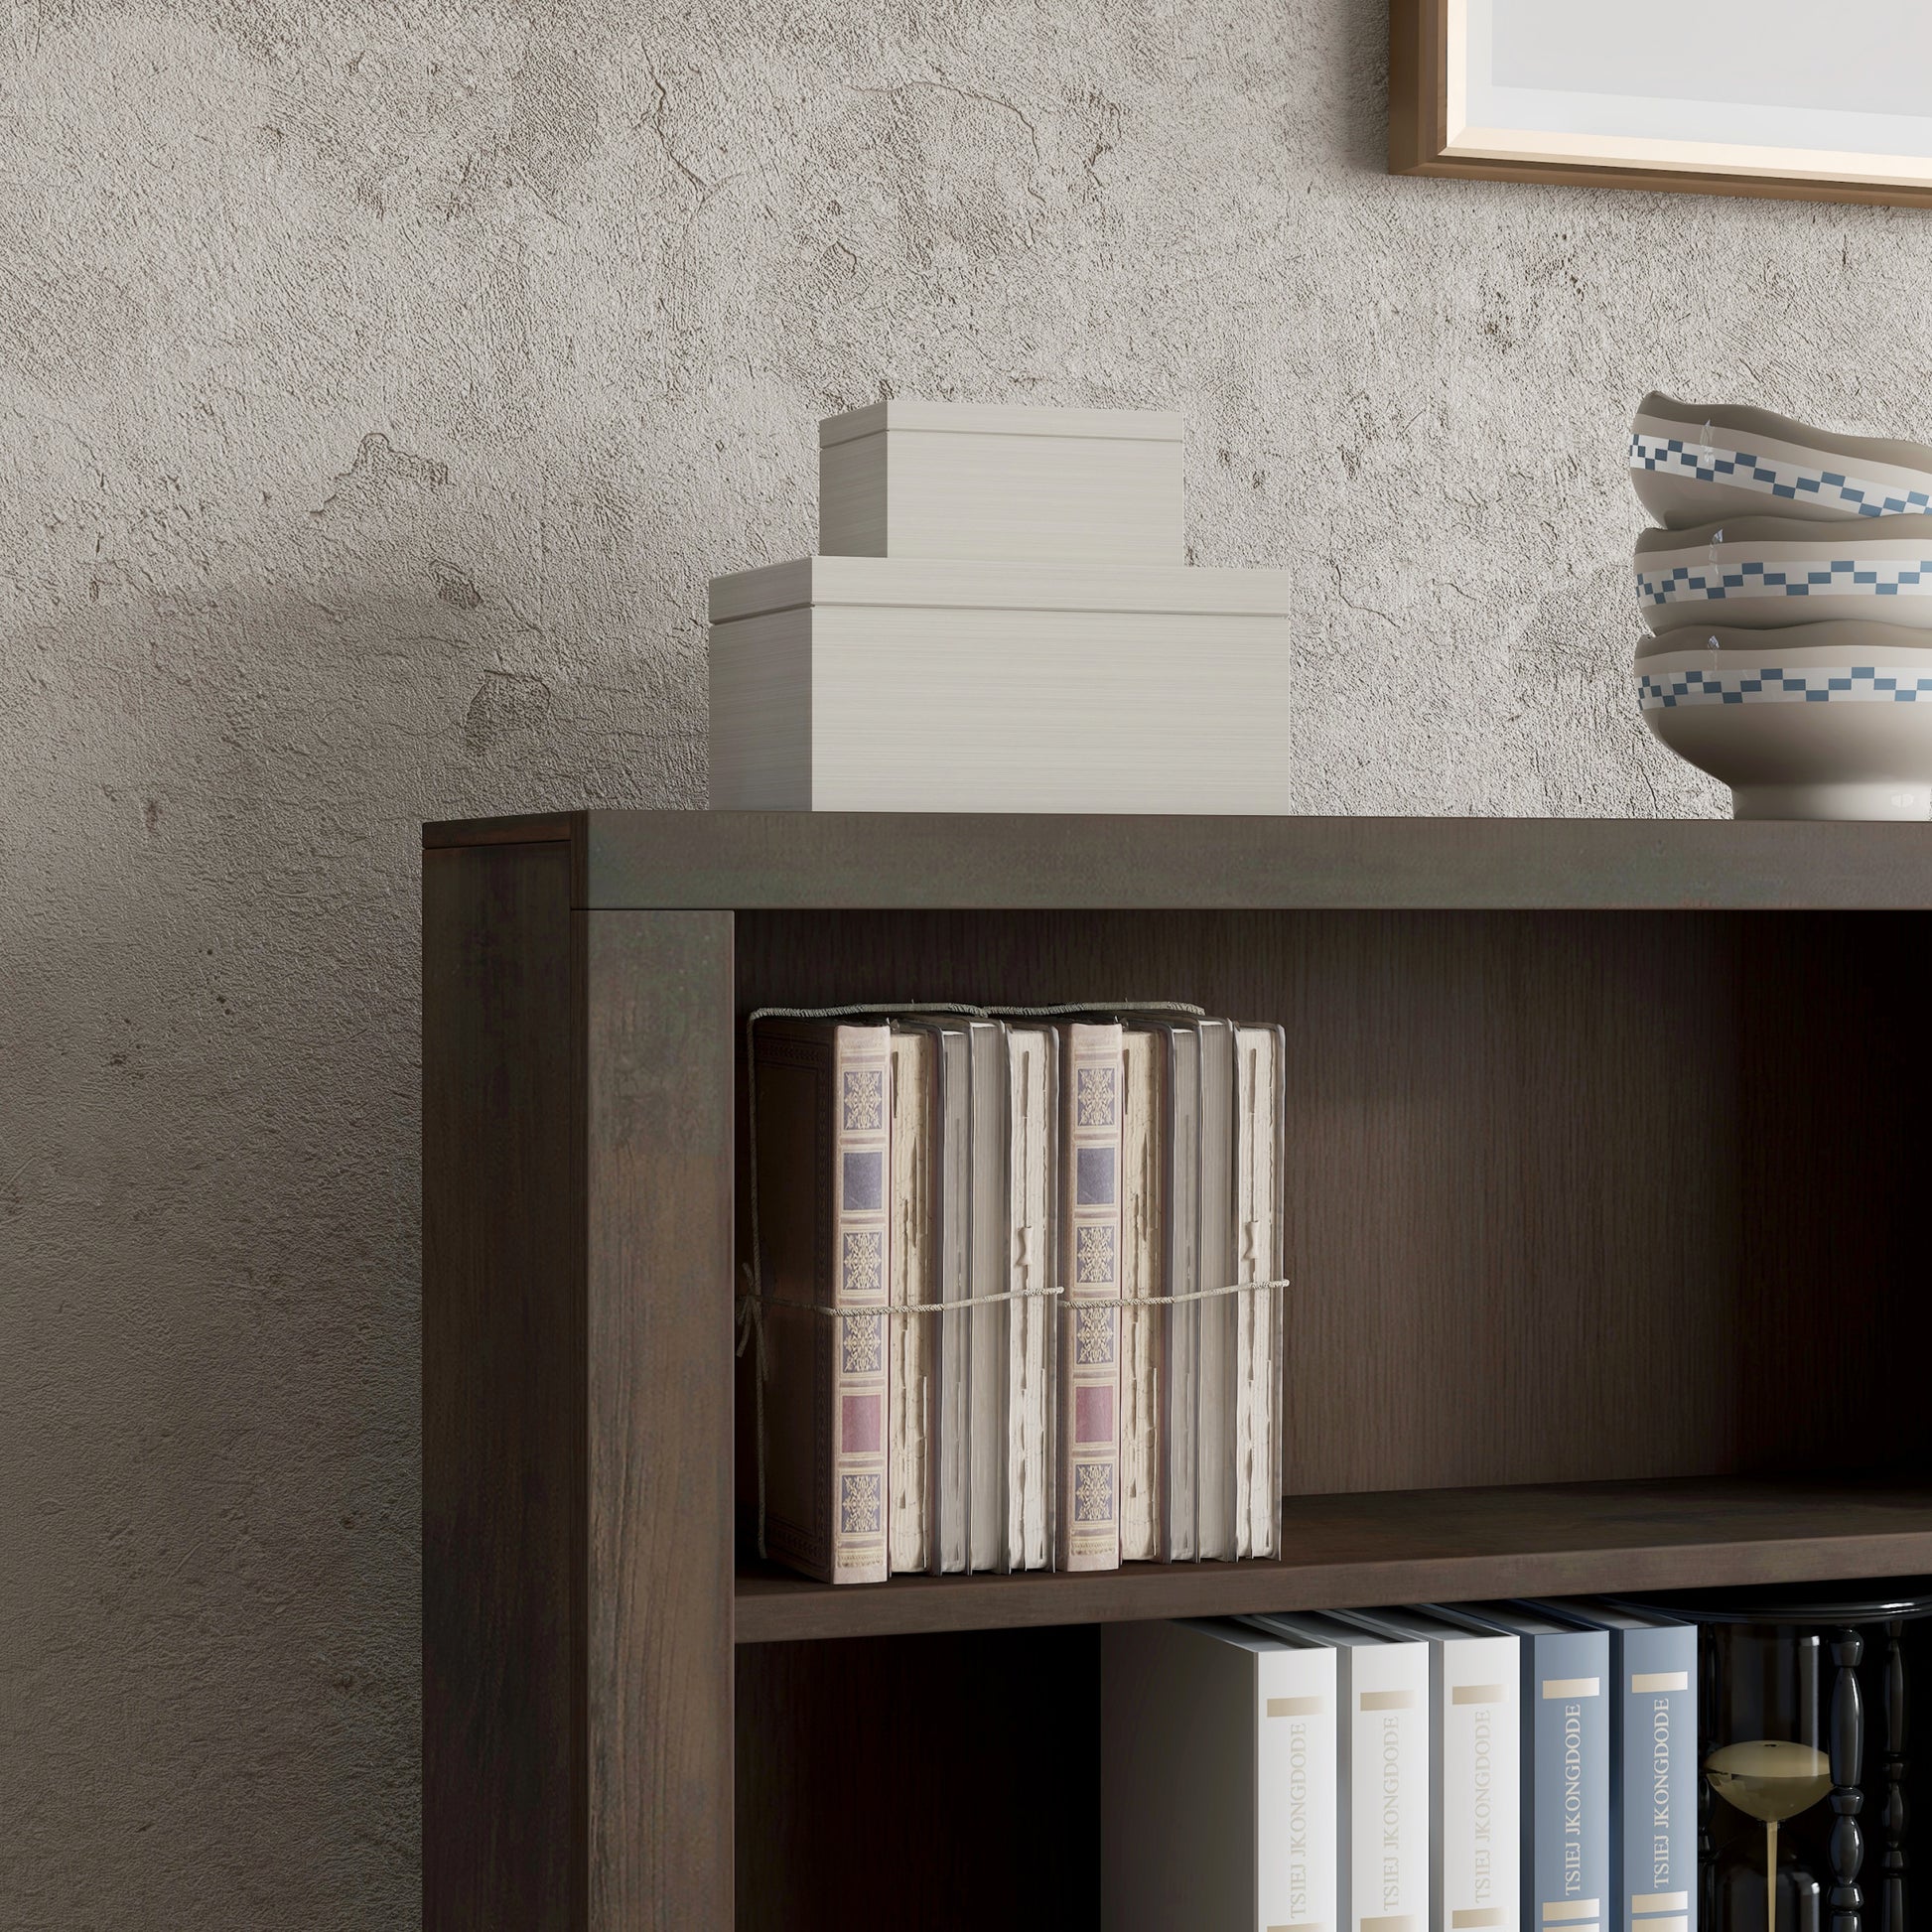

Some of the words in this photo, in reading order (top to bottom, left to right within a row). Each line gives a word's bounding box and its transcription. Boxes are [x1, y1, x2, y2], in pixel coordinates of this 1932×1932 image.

[1290, 1723, 1307, 1857] JKONGDODE
[1383, 1717, 1399, 1850] JKONGDODE
[1474, 1710, 1490, 1842] JKONGDODE
[1565, 1704, 1581, 1835] JKONGDODE
[1653, 1698, 1670, 1828] JKONGDODE
[1290, 1863, 1307, 1918] TSIEJ
[1383, 1857, 1399, 1911] TSIEJ
[1474, 1849, 1490, 1903] TSIEJ
[1565, 1842, 1581, 1895] TSIEJ
[1653, 1835, 1670, 1887] TSIEJ
